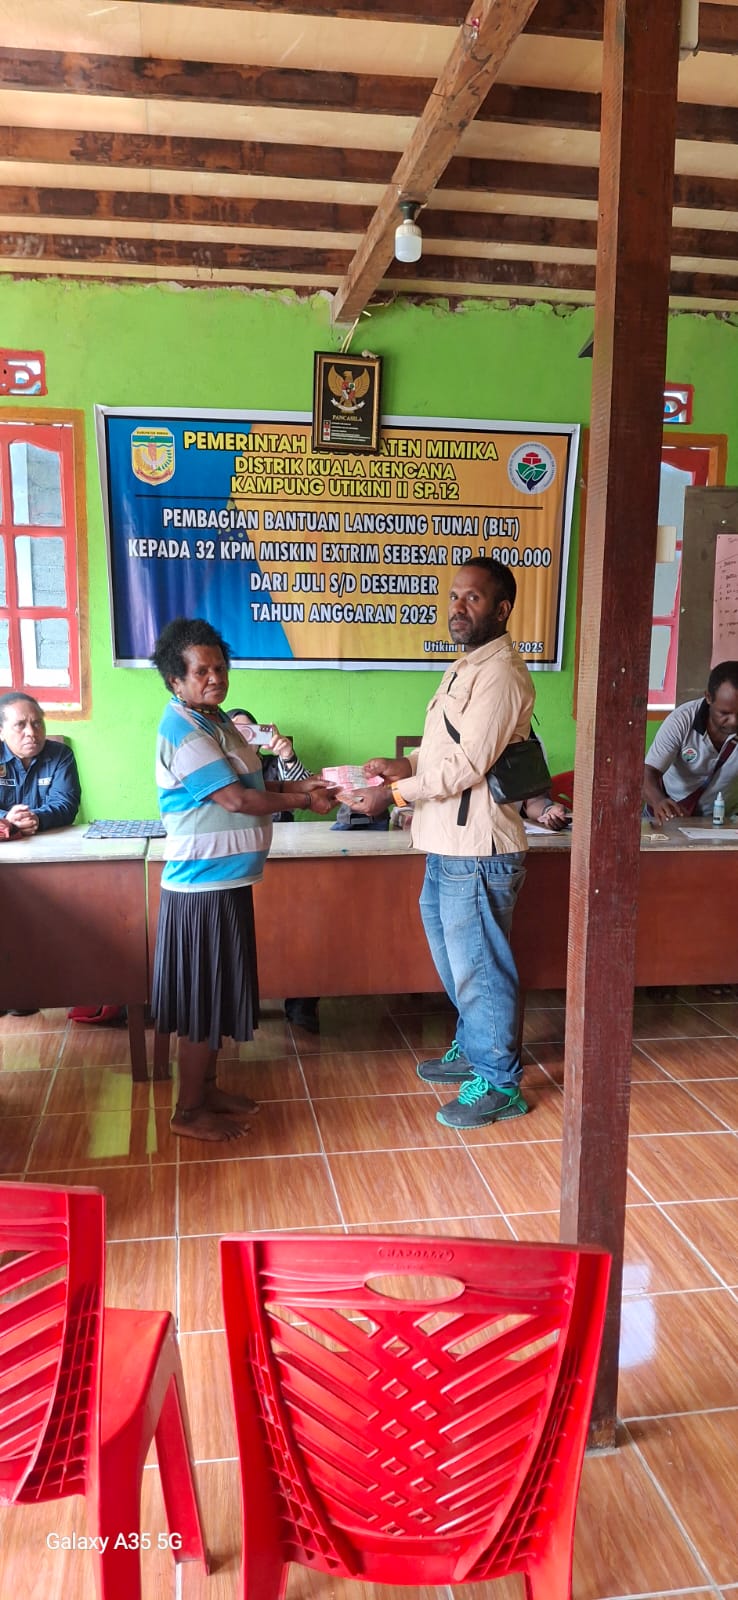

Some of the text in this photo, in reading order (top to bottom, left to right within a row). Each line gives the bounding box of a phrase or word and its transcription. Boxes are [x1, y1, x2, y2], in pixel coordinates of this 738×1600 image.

[184, 431, 306, 453] PEMERINTAH
[426, 440, 498, 460] MIMIKA
[235, 456, 456, 480] DISTRIK KUALA KENCANA
[230, 476, 460, 500] KAMPUNG UTIKINI II SP.12
[162, 508, 520, 540] PEMBAGIAN BANTUAN LANGSUNG TUNAI (BLT)
[128, 538, 191, 560] KEPADA
[195, 540, 215, 560] 32
[220, 540, 256, 561] KPM
[259, 541, 317, 562] MISKIN
[322, 542, 379, 564] EXTRIM
[383, 544, 448, 565] SEBESAR
[250, 572, 439, 597] DARI JULI S/D DESEMBER
[250, 603, 437, 625] TAHUN ANGGARAN 2025
[424, 640, 458, 652] Utikini
[518, 641, 545, 653] 2025
